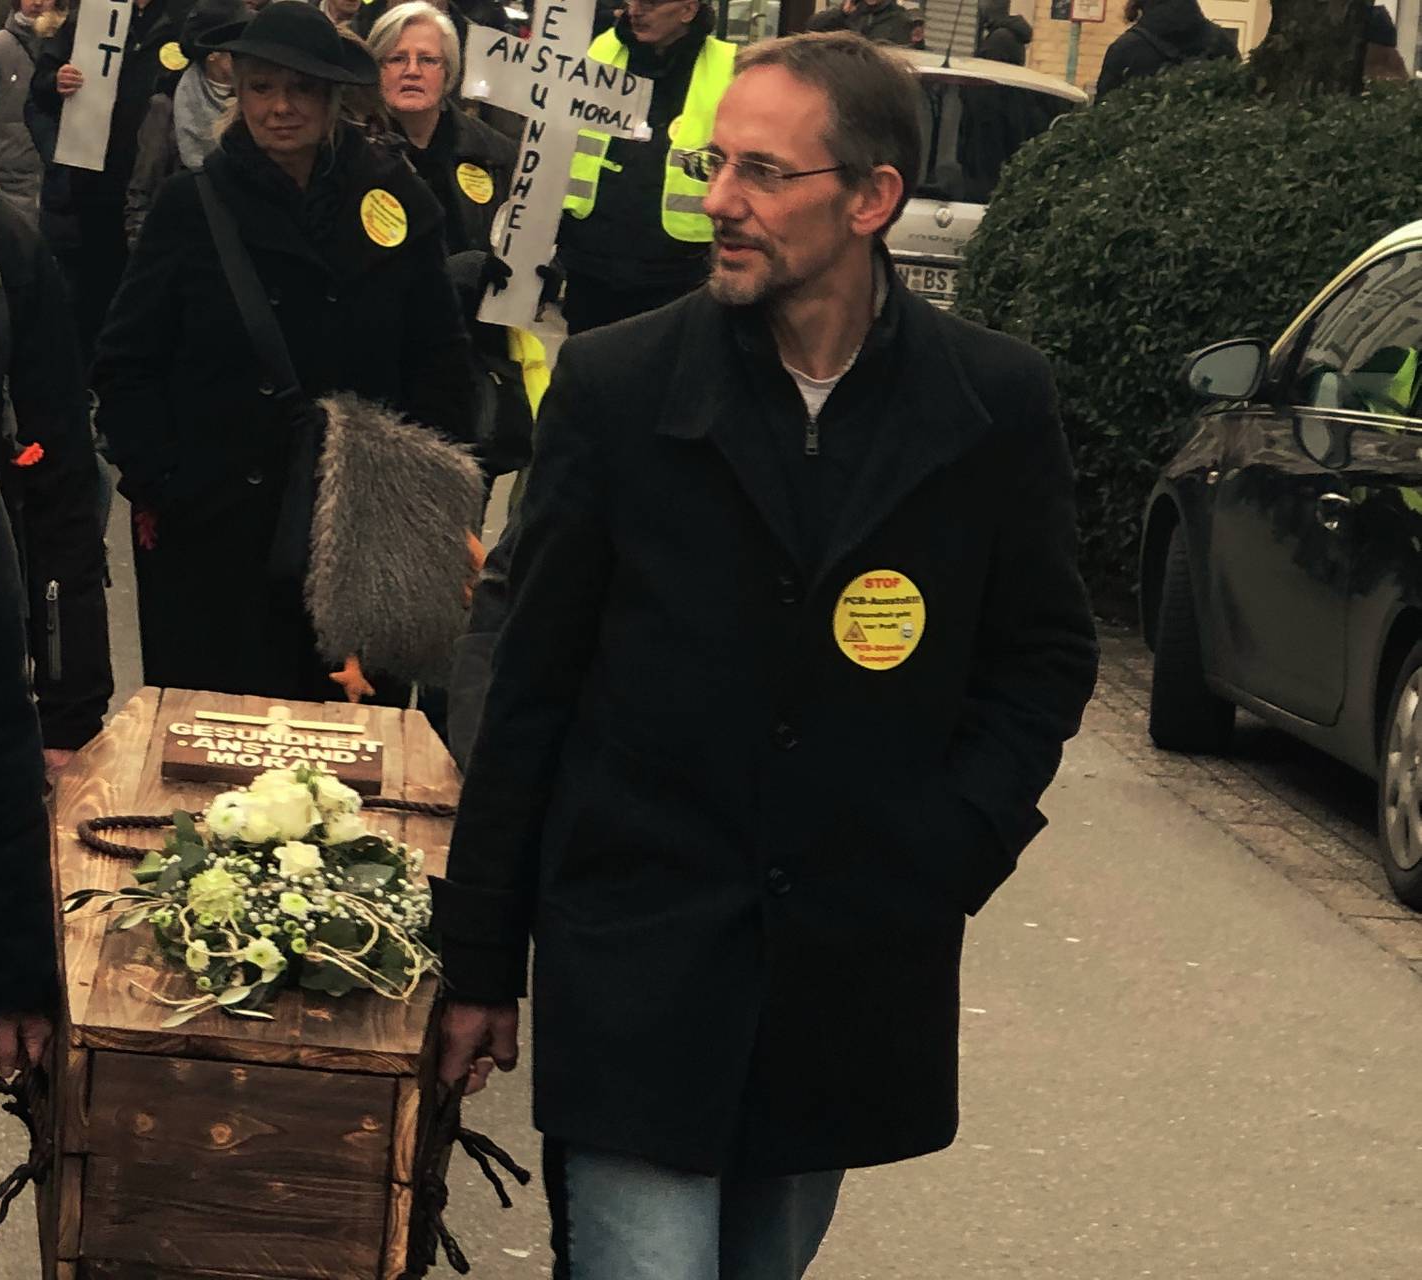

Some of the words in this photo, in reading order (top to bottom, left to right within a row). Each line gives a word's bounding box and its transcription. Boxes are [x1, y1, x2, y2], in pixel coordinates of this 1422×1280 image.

[98, 0, 128, 77] IT
[487, 36, 637, 96] ANSTAND
[502, 0, 567, 256] ESUNDHEI
[570, 97, 633, 131] MORAL
[864, 577, 901, 589] STOP
[168, 722, 383, 752] GESUNDHEIT
[191, 736, 358, 764] ANSTAND
[206, 751, 338, 775] MORAL
